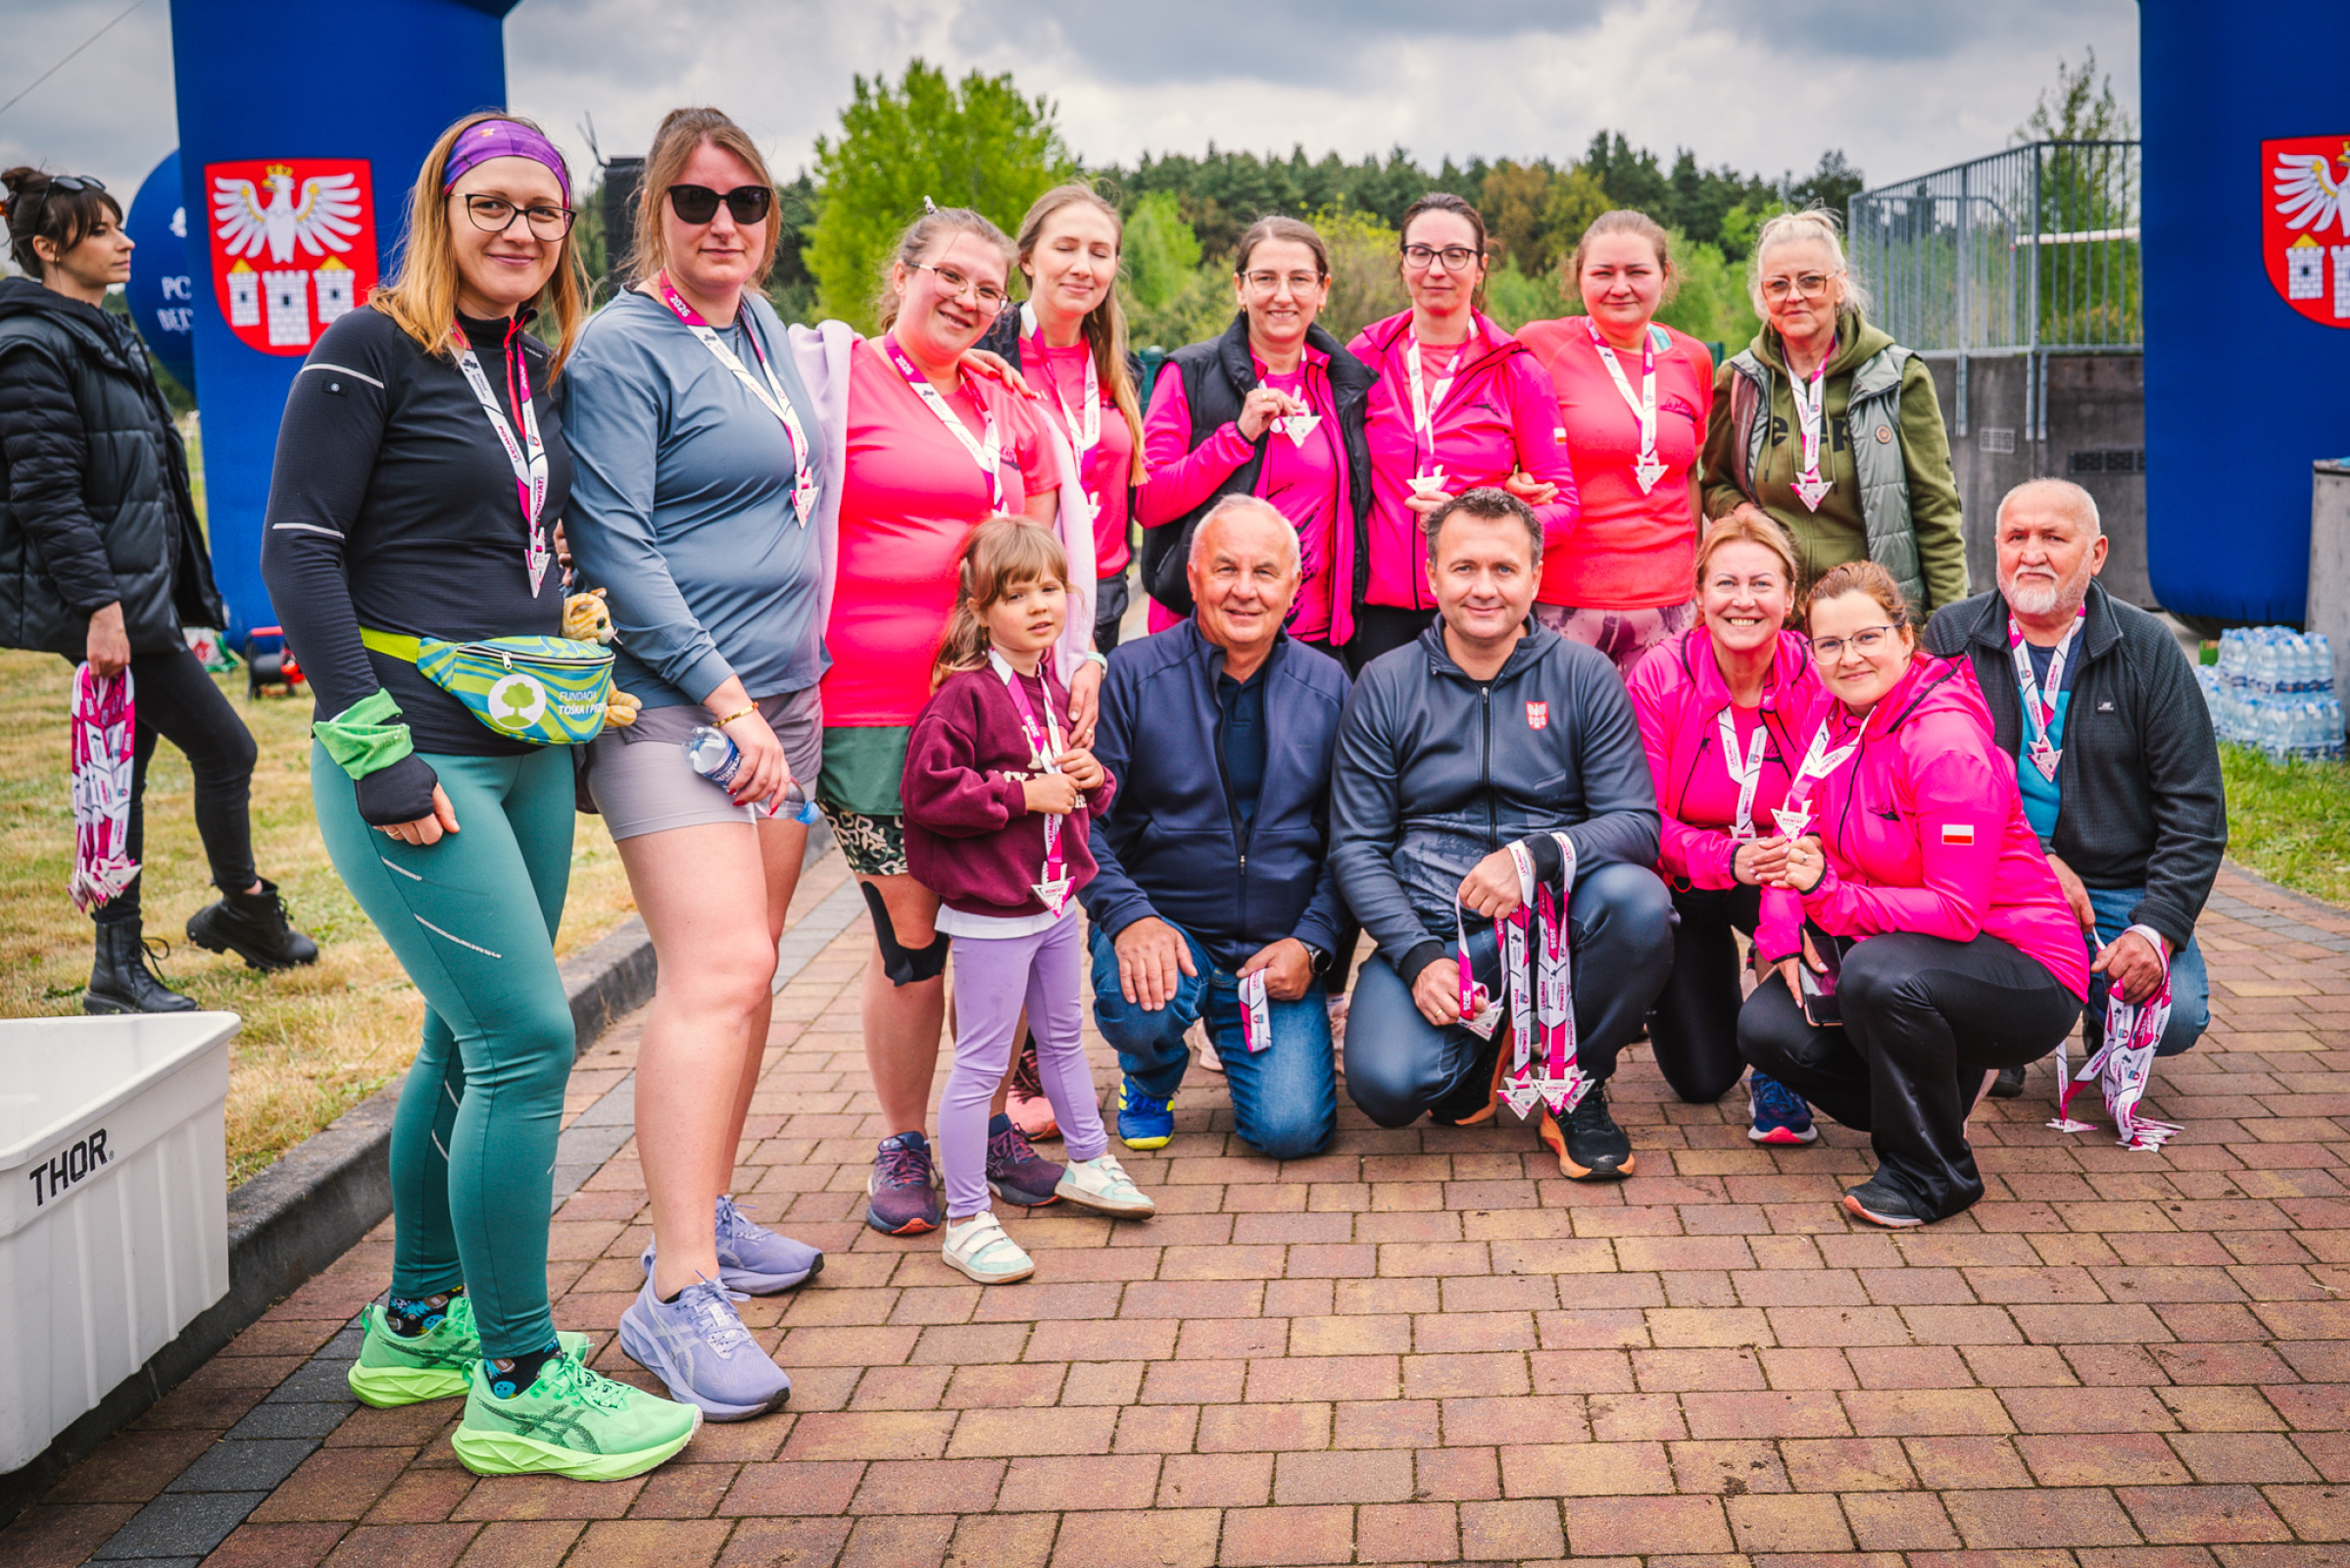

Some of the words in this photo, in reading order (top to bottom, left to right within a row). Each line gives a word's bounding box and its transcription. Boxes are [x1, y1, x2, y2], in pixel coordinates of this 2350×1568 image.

[668, 293, 692, 318] 2026
[498, 424, 519, 461] POWIAT
[28, 1127, 108, 1207] THOR
